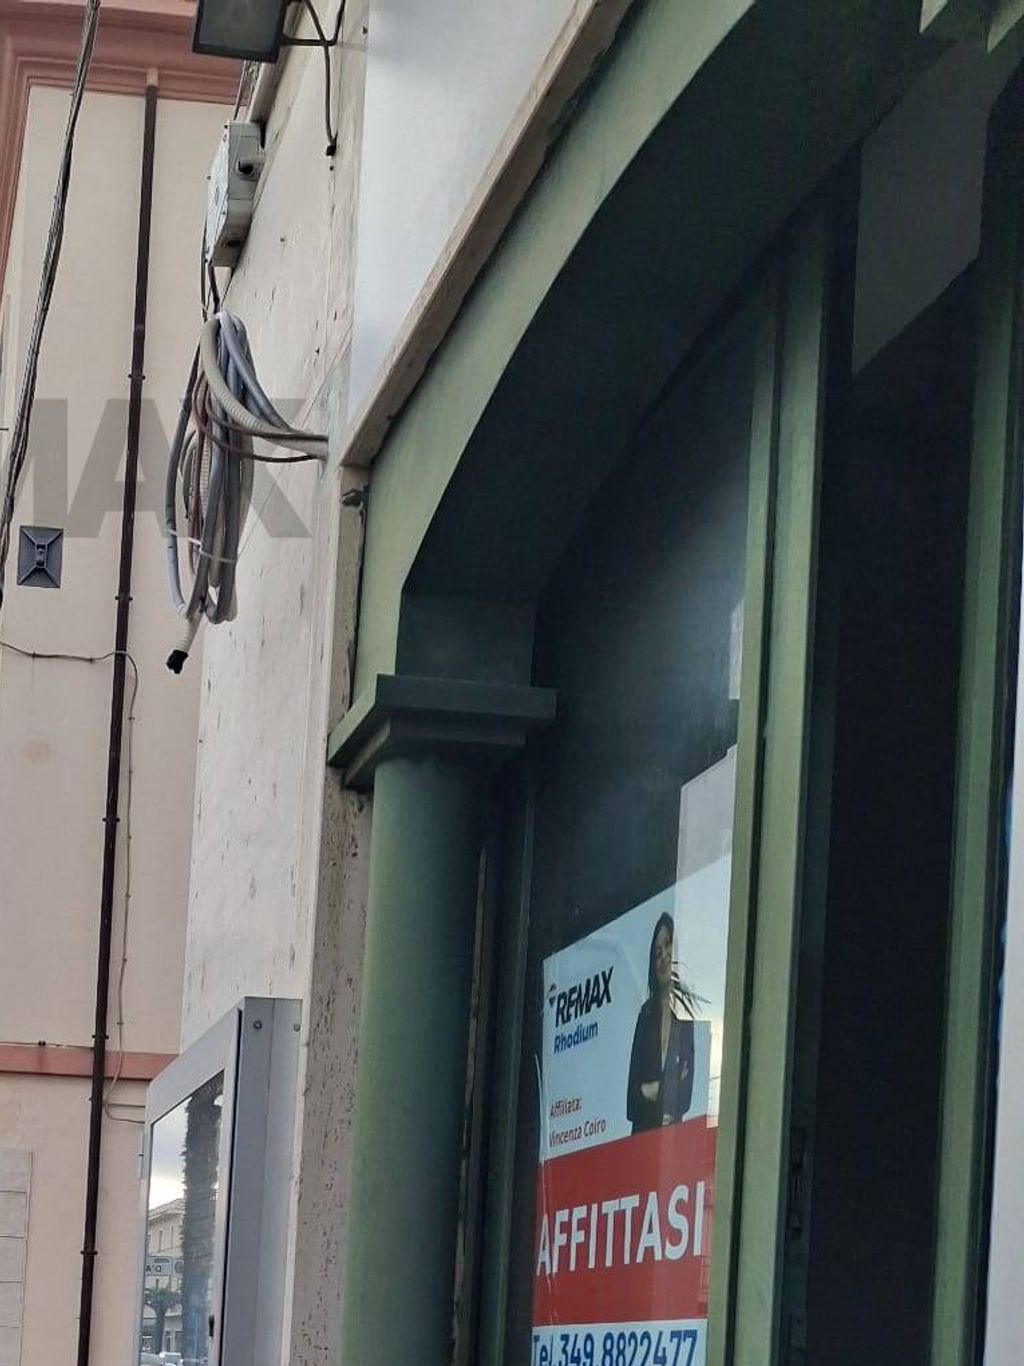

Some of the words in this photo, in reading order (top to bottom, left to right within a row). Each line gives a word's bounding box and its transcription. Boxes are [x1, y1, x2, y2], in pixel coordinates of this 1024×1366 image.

[553, 1022, 598, 1054] Rhodium
[549, 1127, 582, 1147] Vincenza
[583, 1118, 607, 1137] Coiro
[536, 1181, 705, 1276] AFFITTASI
